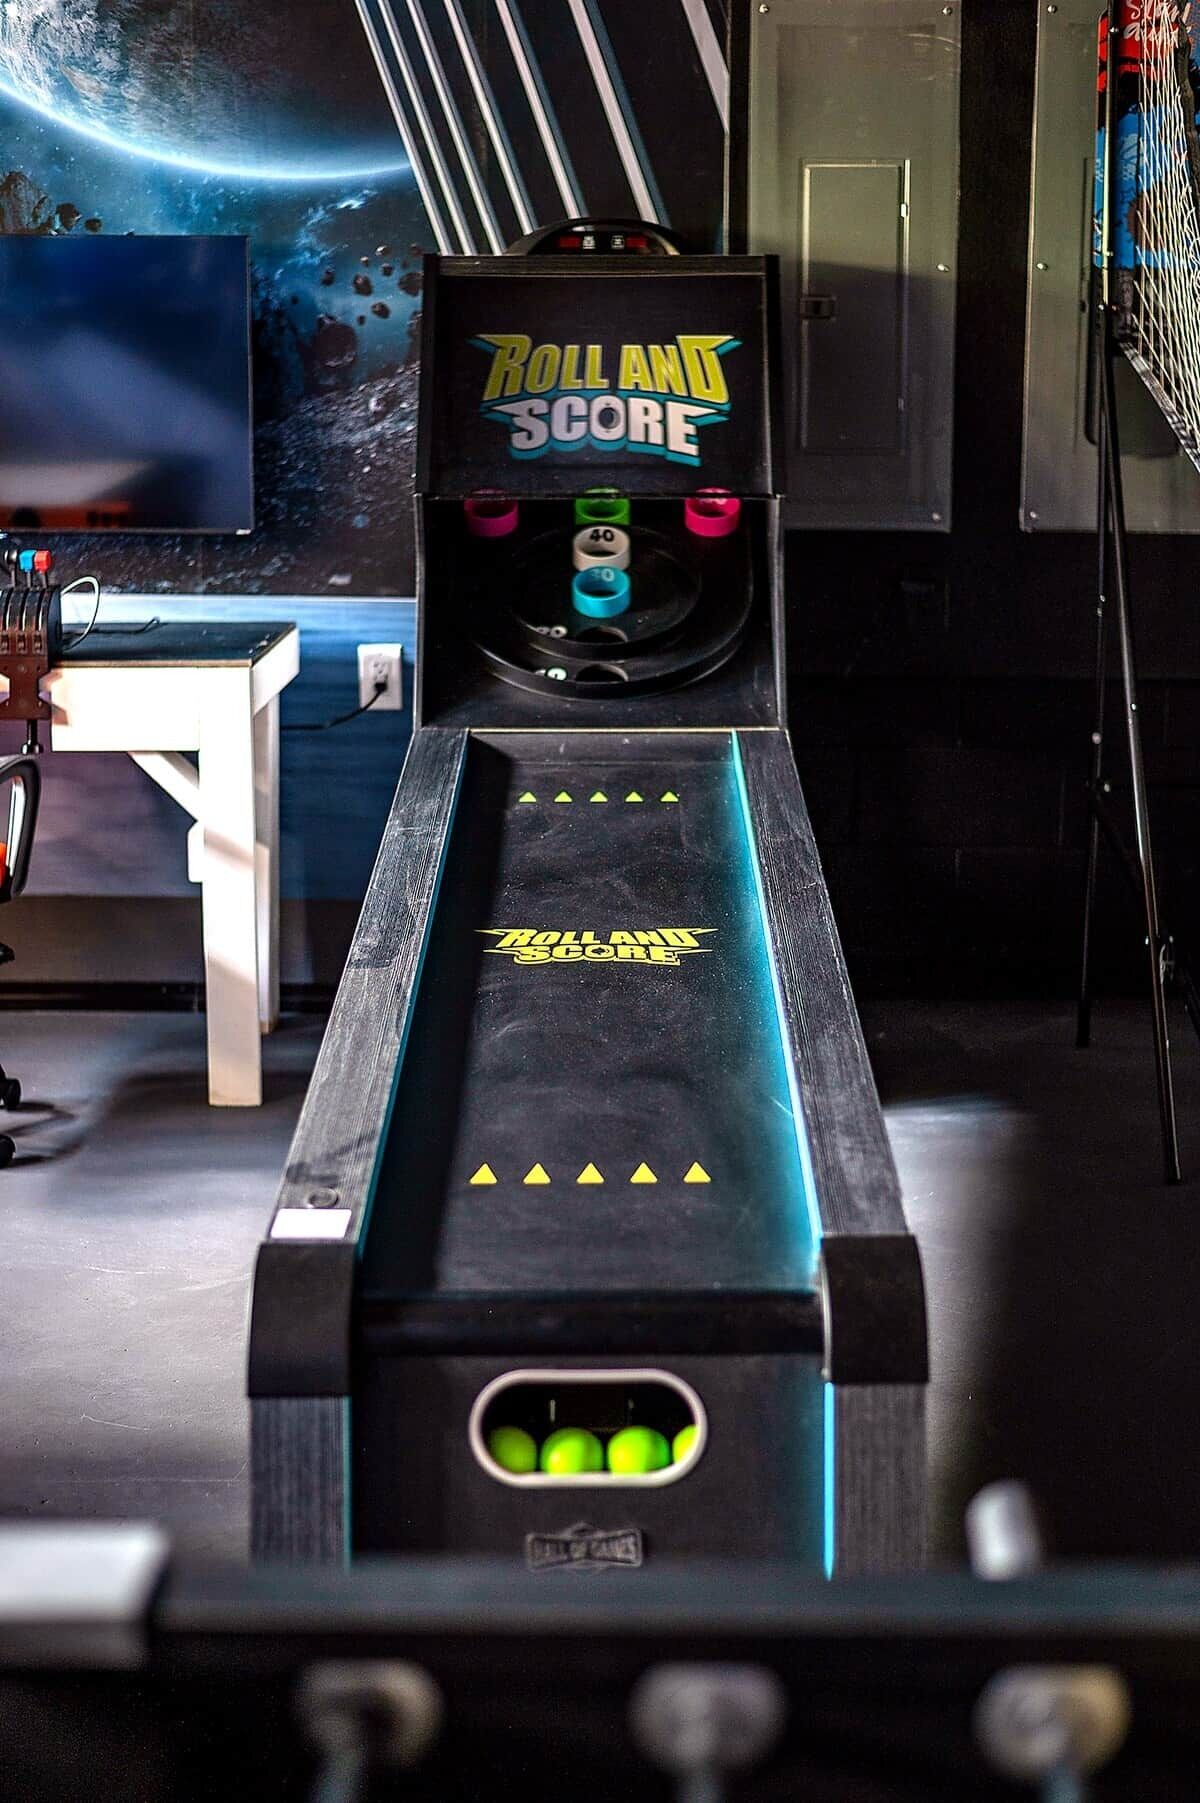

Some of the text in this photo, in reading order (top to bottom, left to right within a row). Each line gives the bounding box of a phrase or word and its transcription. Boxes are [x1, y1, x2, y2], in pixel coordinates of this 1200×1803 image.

[476, 334, 736, 404] ROLL AND
[491, 395, 719, 457] SCORE
[590, 529, 614, 542] 40
[480, 928, 713, 948] ROLL AND
[495, 945, 702, 965] SCORE
